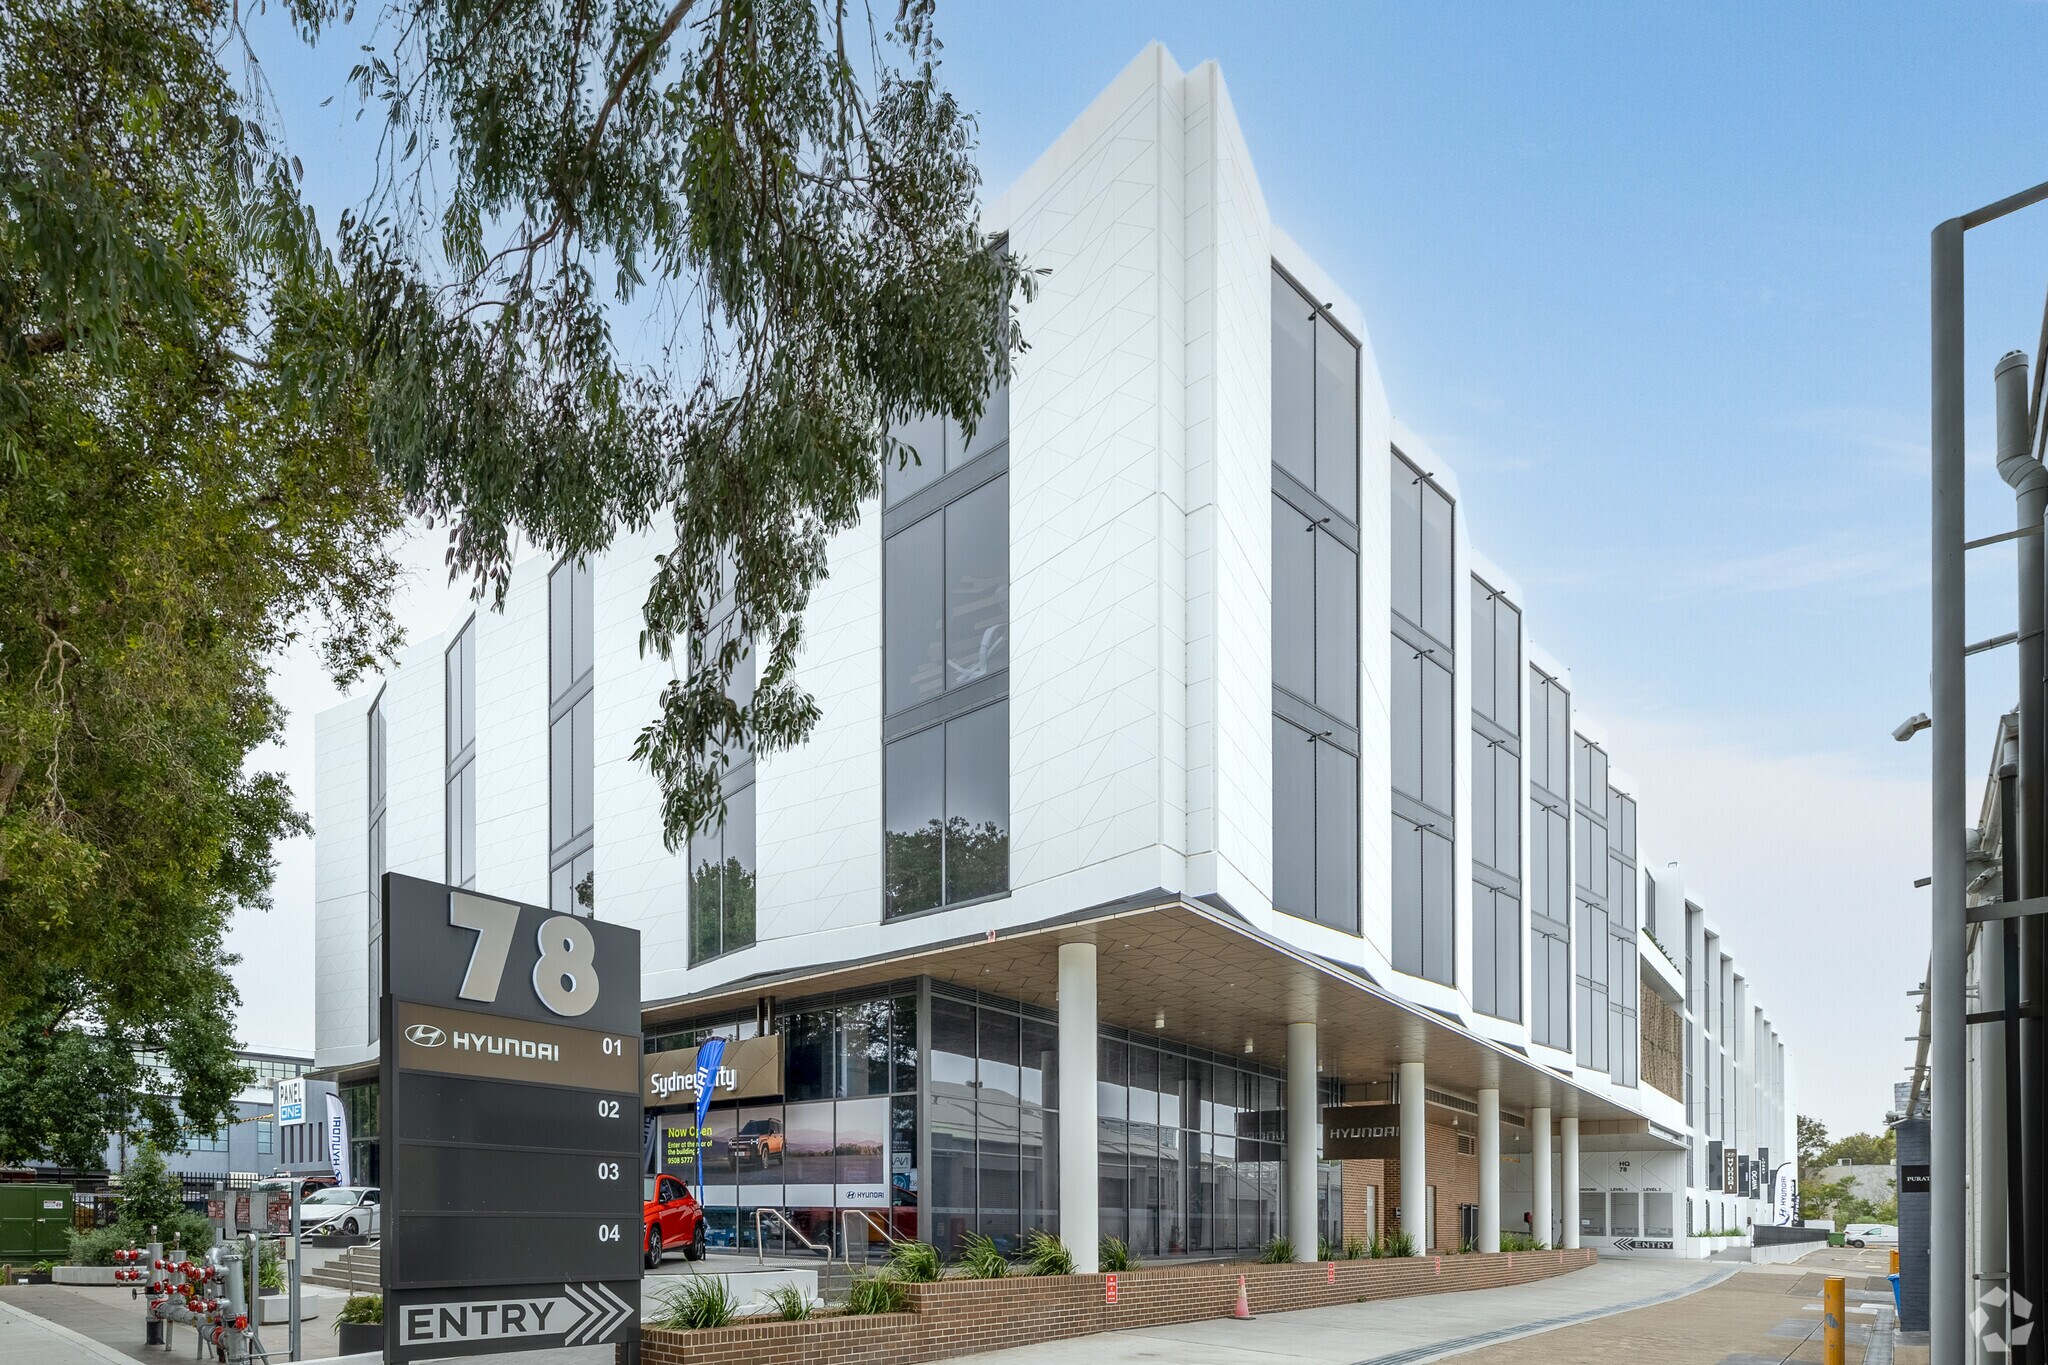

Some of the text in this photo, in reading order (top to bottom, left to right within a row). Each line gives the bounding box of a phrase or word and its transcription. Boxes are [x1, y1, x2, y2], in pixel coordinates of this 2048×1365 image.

[449, 891, 600, 1018] 78
[453, 1031, 622, 1062] HYUNDAI 01
[281, 1082, 302, 1105] PANEL
[281, 1105, 302, 1119] ONE
[598, 1100, 620, 1119] 02
[668, 1127, 687, 1137] Now
[1330, 1126, 1400, 1139] HYUNDAI
[598, 1162, 620, 1181] 03
[857, 1191, 885, 1199] HYUNDAI
[598, 1224, 620, 1242] 04
[407, 1301, 555, 1341] ENTRY
